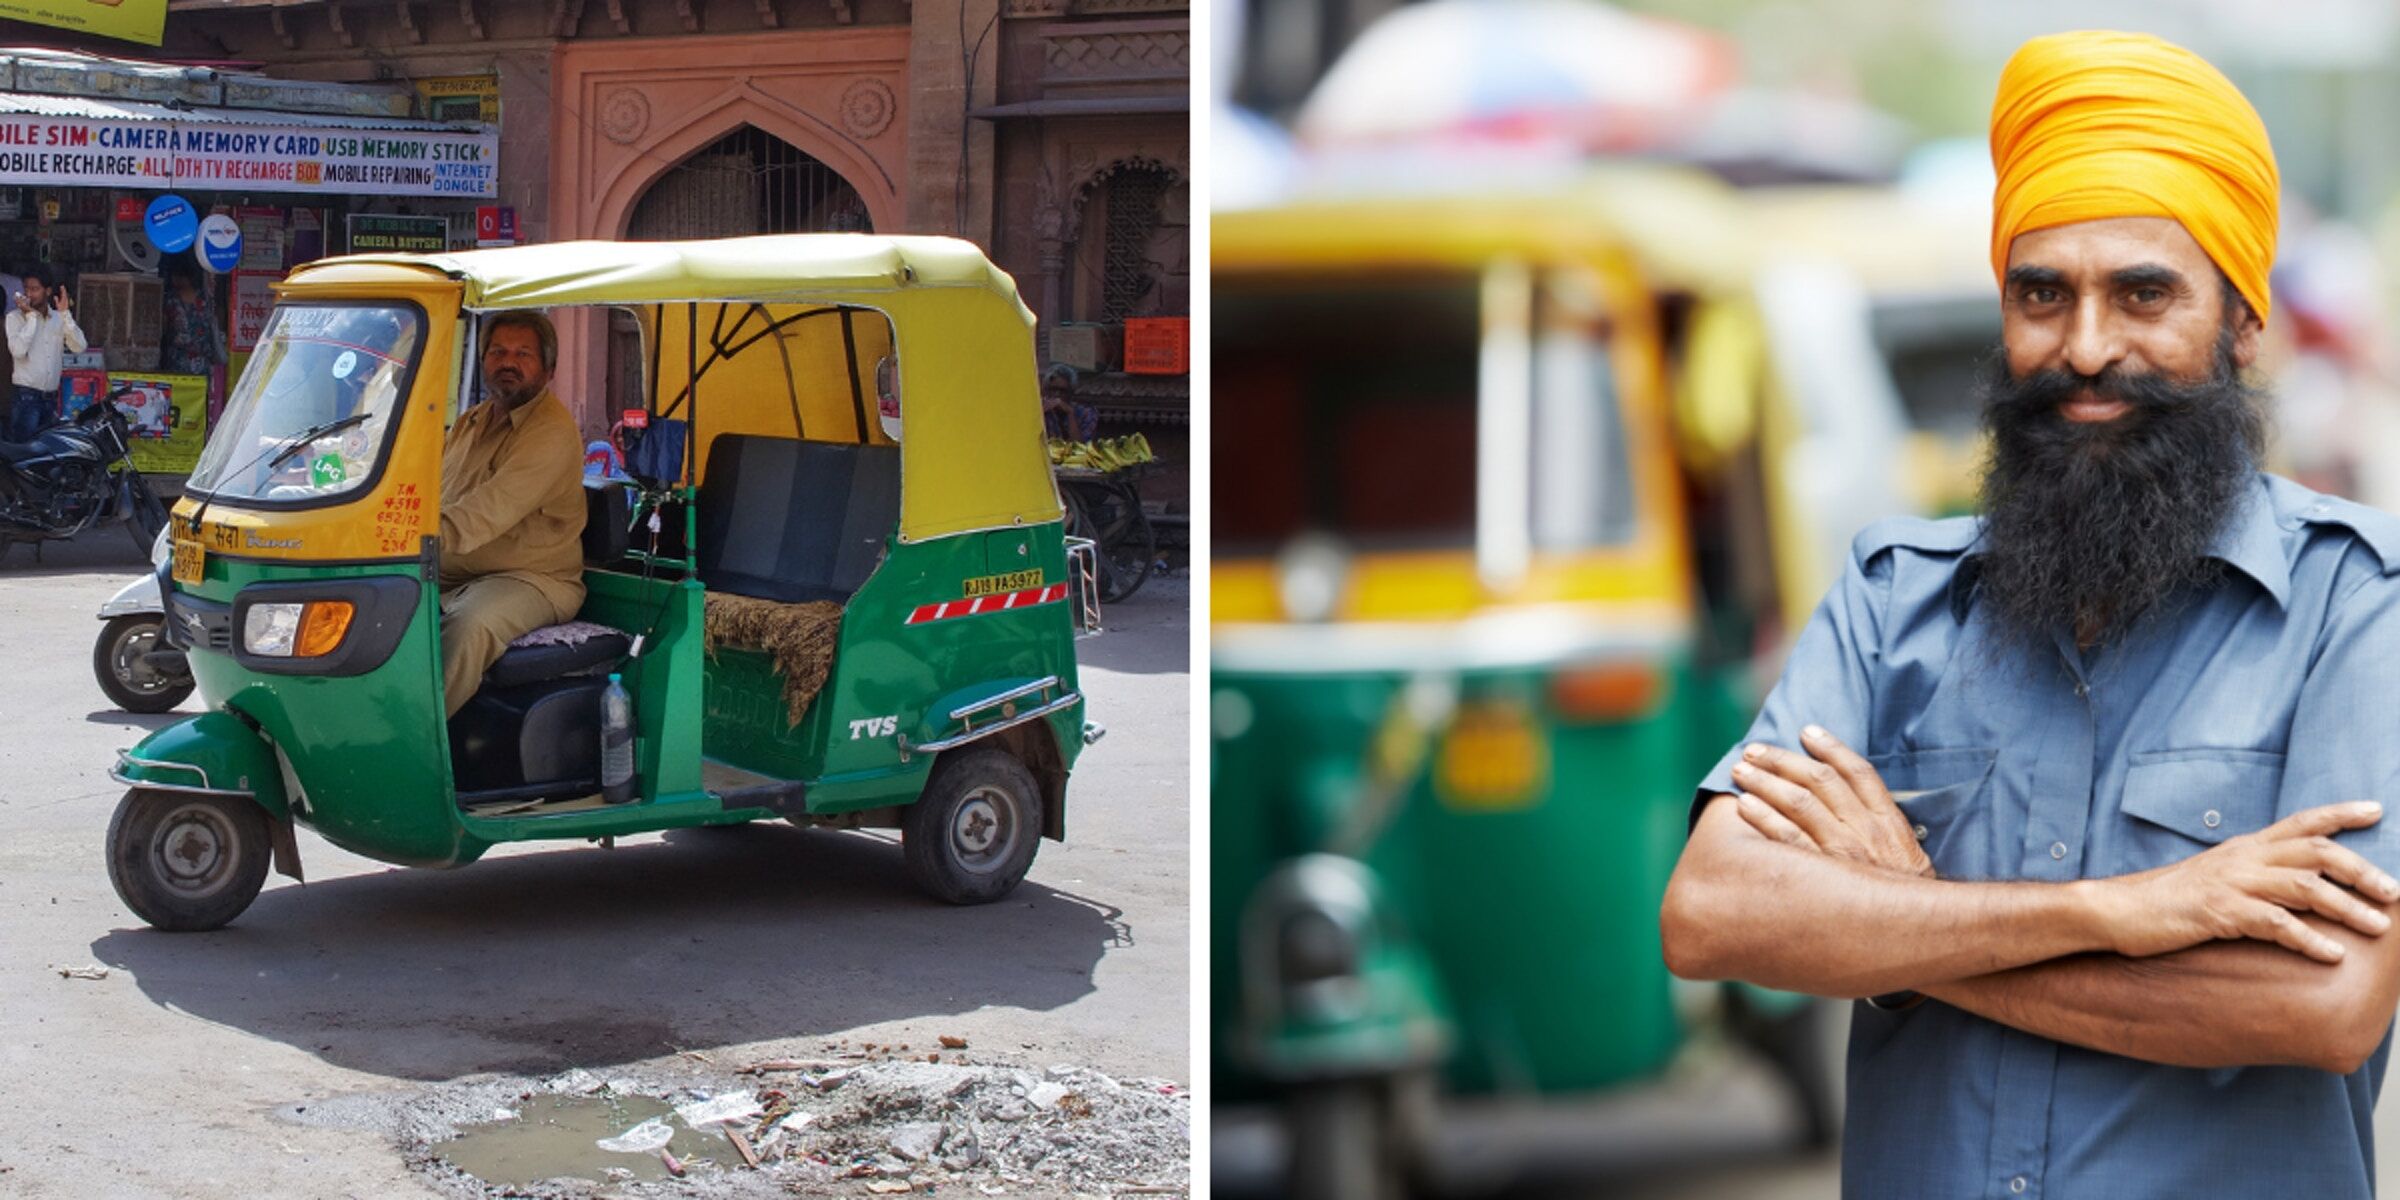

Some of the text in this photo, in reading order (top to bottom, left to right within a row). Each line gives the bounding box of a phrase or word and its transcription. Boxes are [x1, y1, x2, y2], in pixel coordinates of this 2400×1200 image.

[46, 125, 89, 146] SIM
[99, 127, 181, 150] CAMERA
[187, 131, 270, 154] MEMORY
[274, 135, 320, 156] CARD
[326, 138, 357, 157] USB
[362, 139, 428, 159] MEMORY
[432, 143, 481, 161] STICK
[53, 154, 136, 176] RECHARGE
[143, 157, 171, 177] ALL
[175, 158, 203, 178] DTH
[206, 159, 223, 179] TV
[226, 160, 292, 181] RECHARGE
[296, 161, 321, 182] BOX
[324, 164, 368, 183] MOBILE
[371, 165, 431, 185] REPAIRING
[433, 163, 492, 179] INTERNET
[433, 179, 485, 193] DONGLE
[353, 235, 395, 248] CAMERA
[315, 459, 341, 480] LPG
[849, 715, 898, 740] TVS
